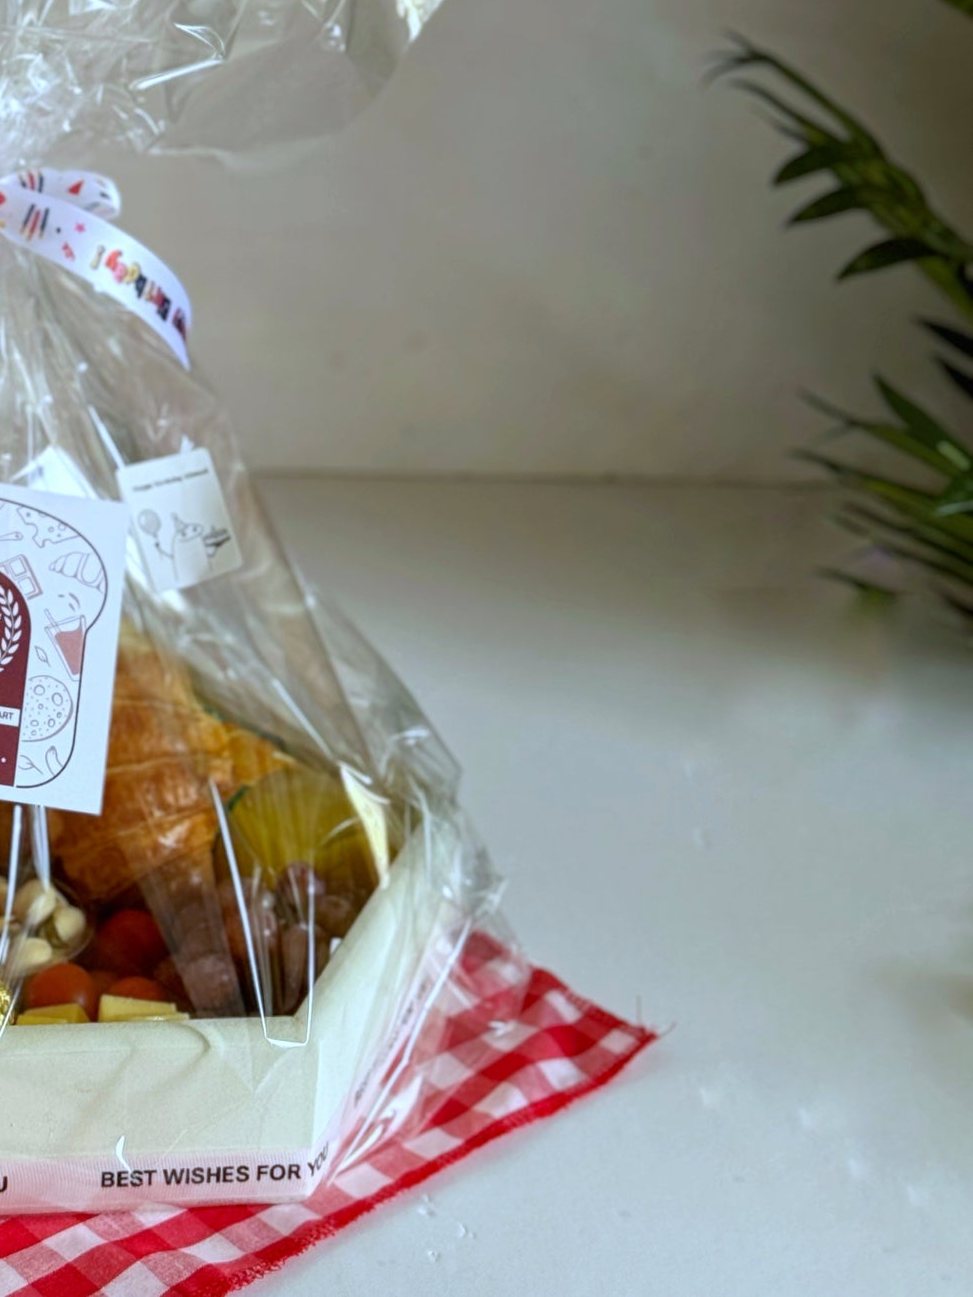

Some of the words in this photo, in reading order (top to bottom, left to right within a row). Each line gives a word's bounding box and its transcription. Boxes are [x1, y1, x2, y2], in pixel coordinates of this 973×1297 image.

[100, 1169, 156, 1188] BEST
[163, 1165, 250, 1185] WISHES
[256, 1163, 301, 1181] FOR
